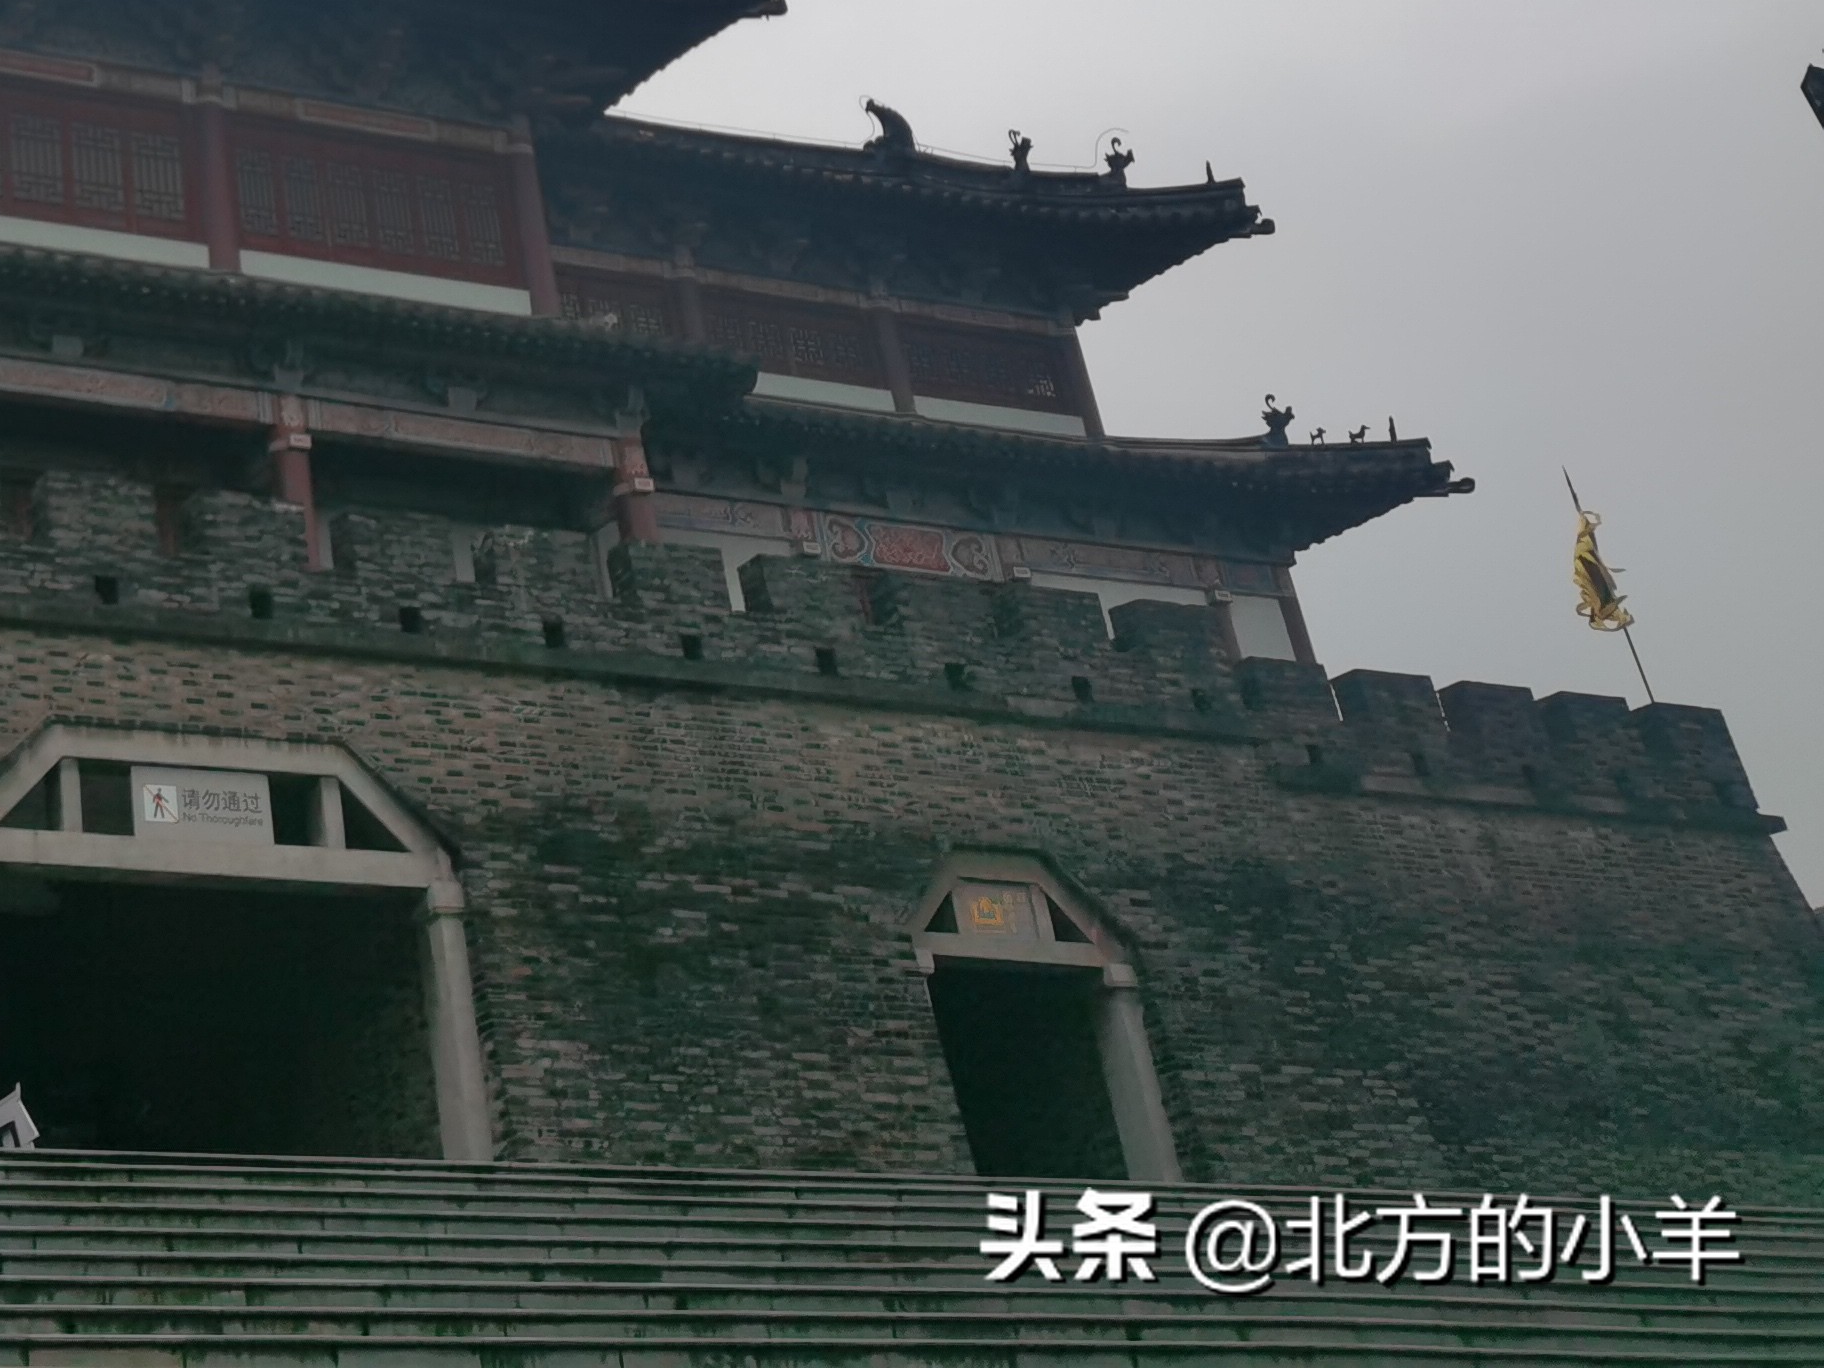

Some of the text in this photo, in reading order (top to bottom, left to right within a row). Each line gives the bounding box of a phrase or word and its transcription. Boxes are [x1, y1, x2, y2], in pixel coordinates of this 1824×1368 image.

[182, 788, 263, 814] 请勿通过
[182, 812, 264, 827] No Thoroughfare
